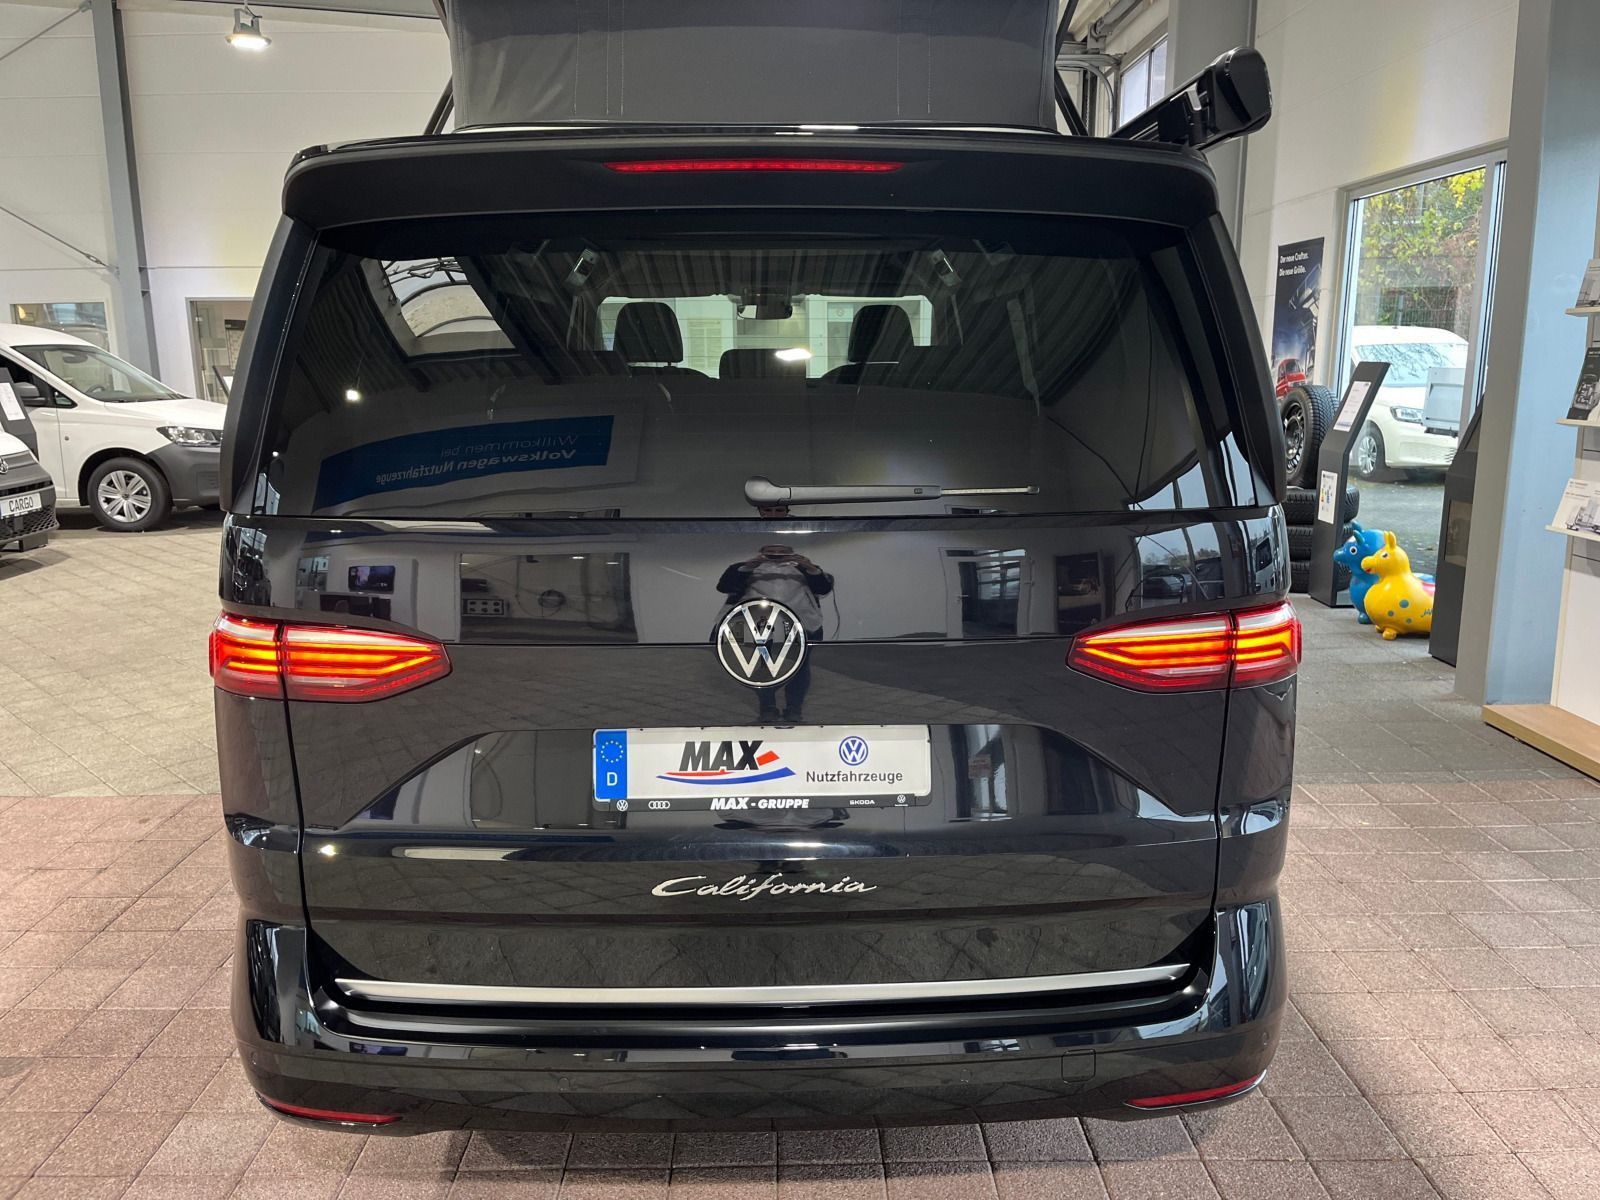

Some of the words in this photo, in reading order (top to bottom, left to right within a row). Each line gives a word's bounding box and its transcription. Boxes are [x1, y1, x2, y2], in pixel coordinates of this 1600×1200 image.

[9, 496, 33, 512] CARGO
[679, 740, 763, 771] MAX
[606, 772, 618, 786] D
[806, 771, 903, 784] Nutzfahrzeuge
[651, 872, 877, 901] California
